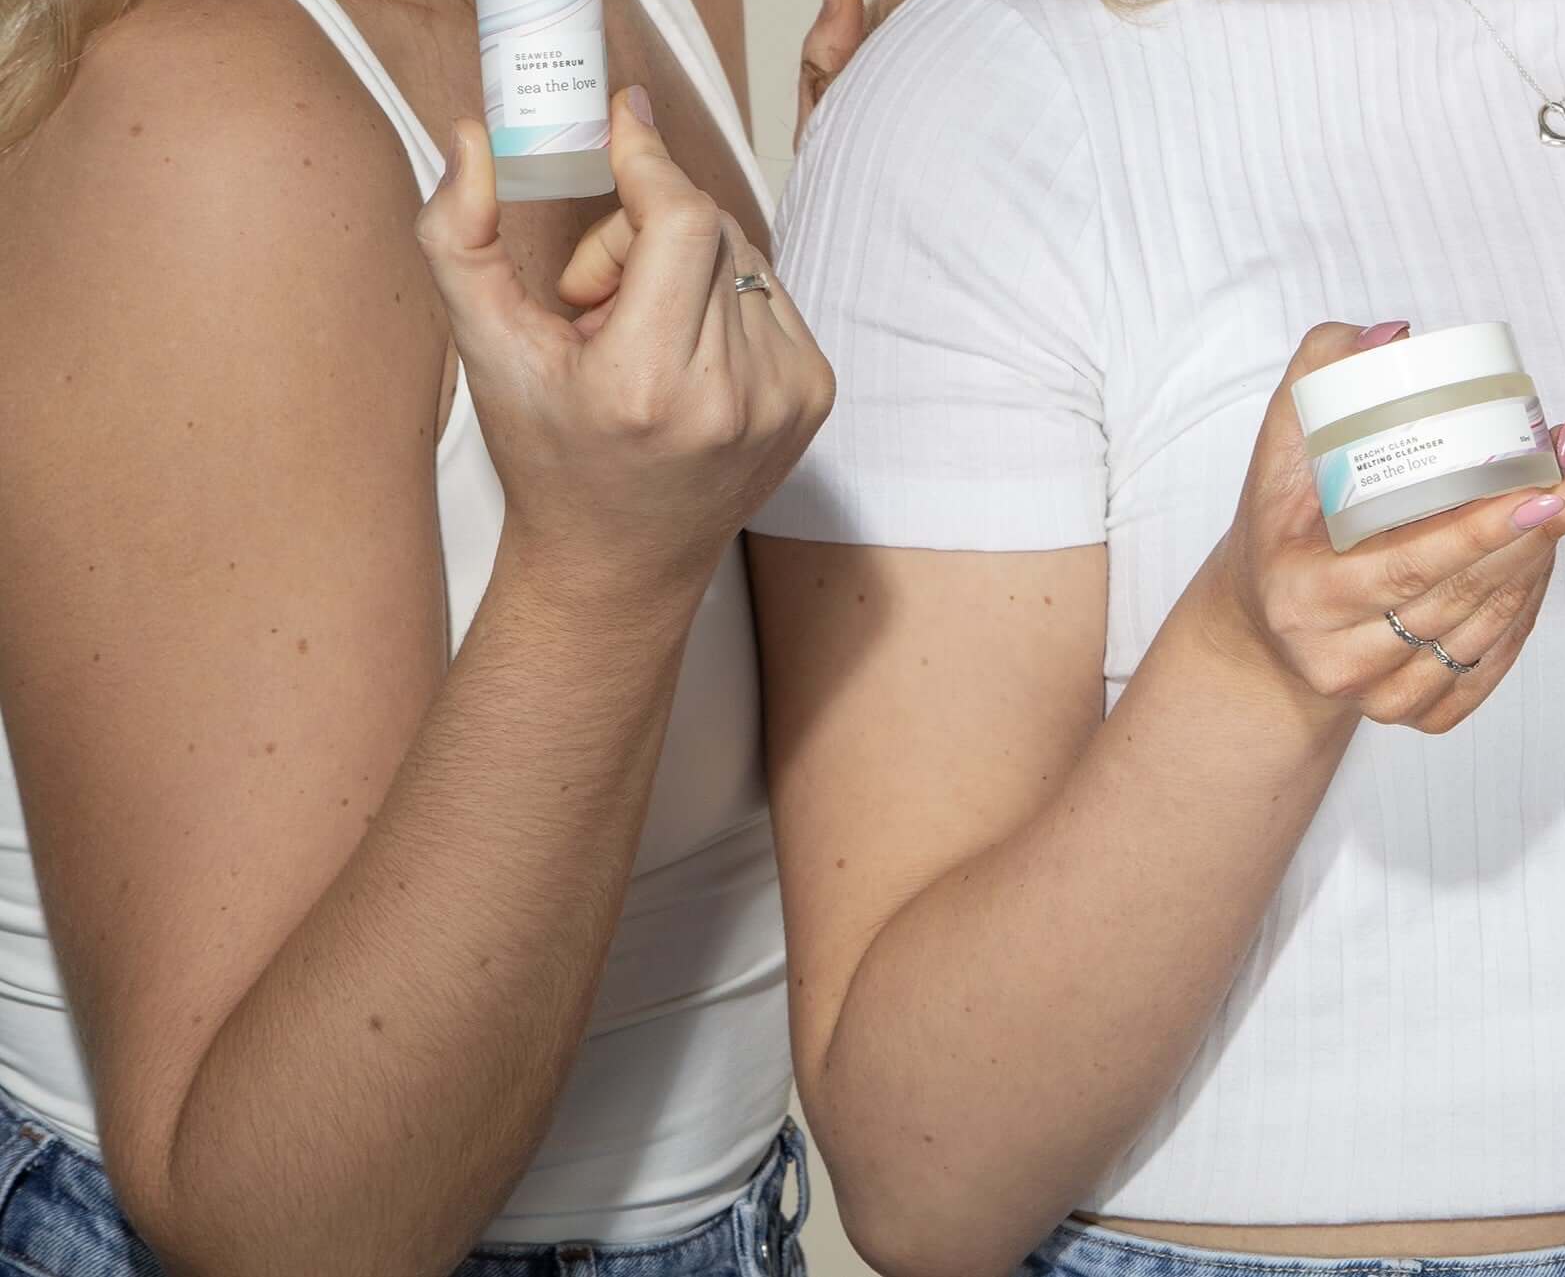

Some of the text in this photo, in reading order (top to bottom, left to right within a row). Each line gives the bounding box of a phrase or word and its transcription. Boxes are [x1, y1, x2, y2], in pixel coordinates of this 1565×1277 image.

[514, 51, 562, 61] SEAWEED
[516, 59, 584, 71] SUPER SERUM
[517, 77, 597, 95] sea the love
[1353, 437, 1418, 463] BEACHY CLEAN
[1356, 438, 1444, 472] MELTING CLEANSER
[1360, 454, 1438, 487] sea the love
